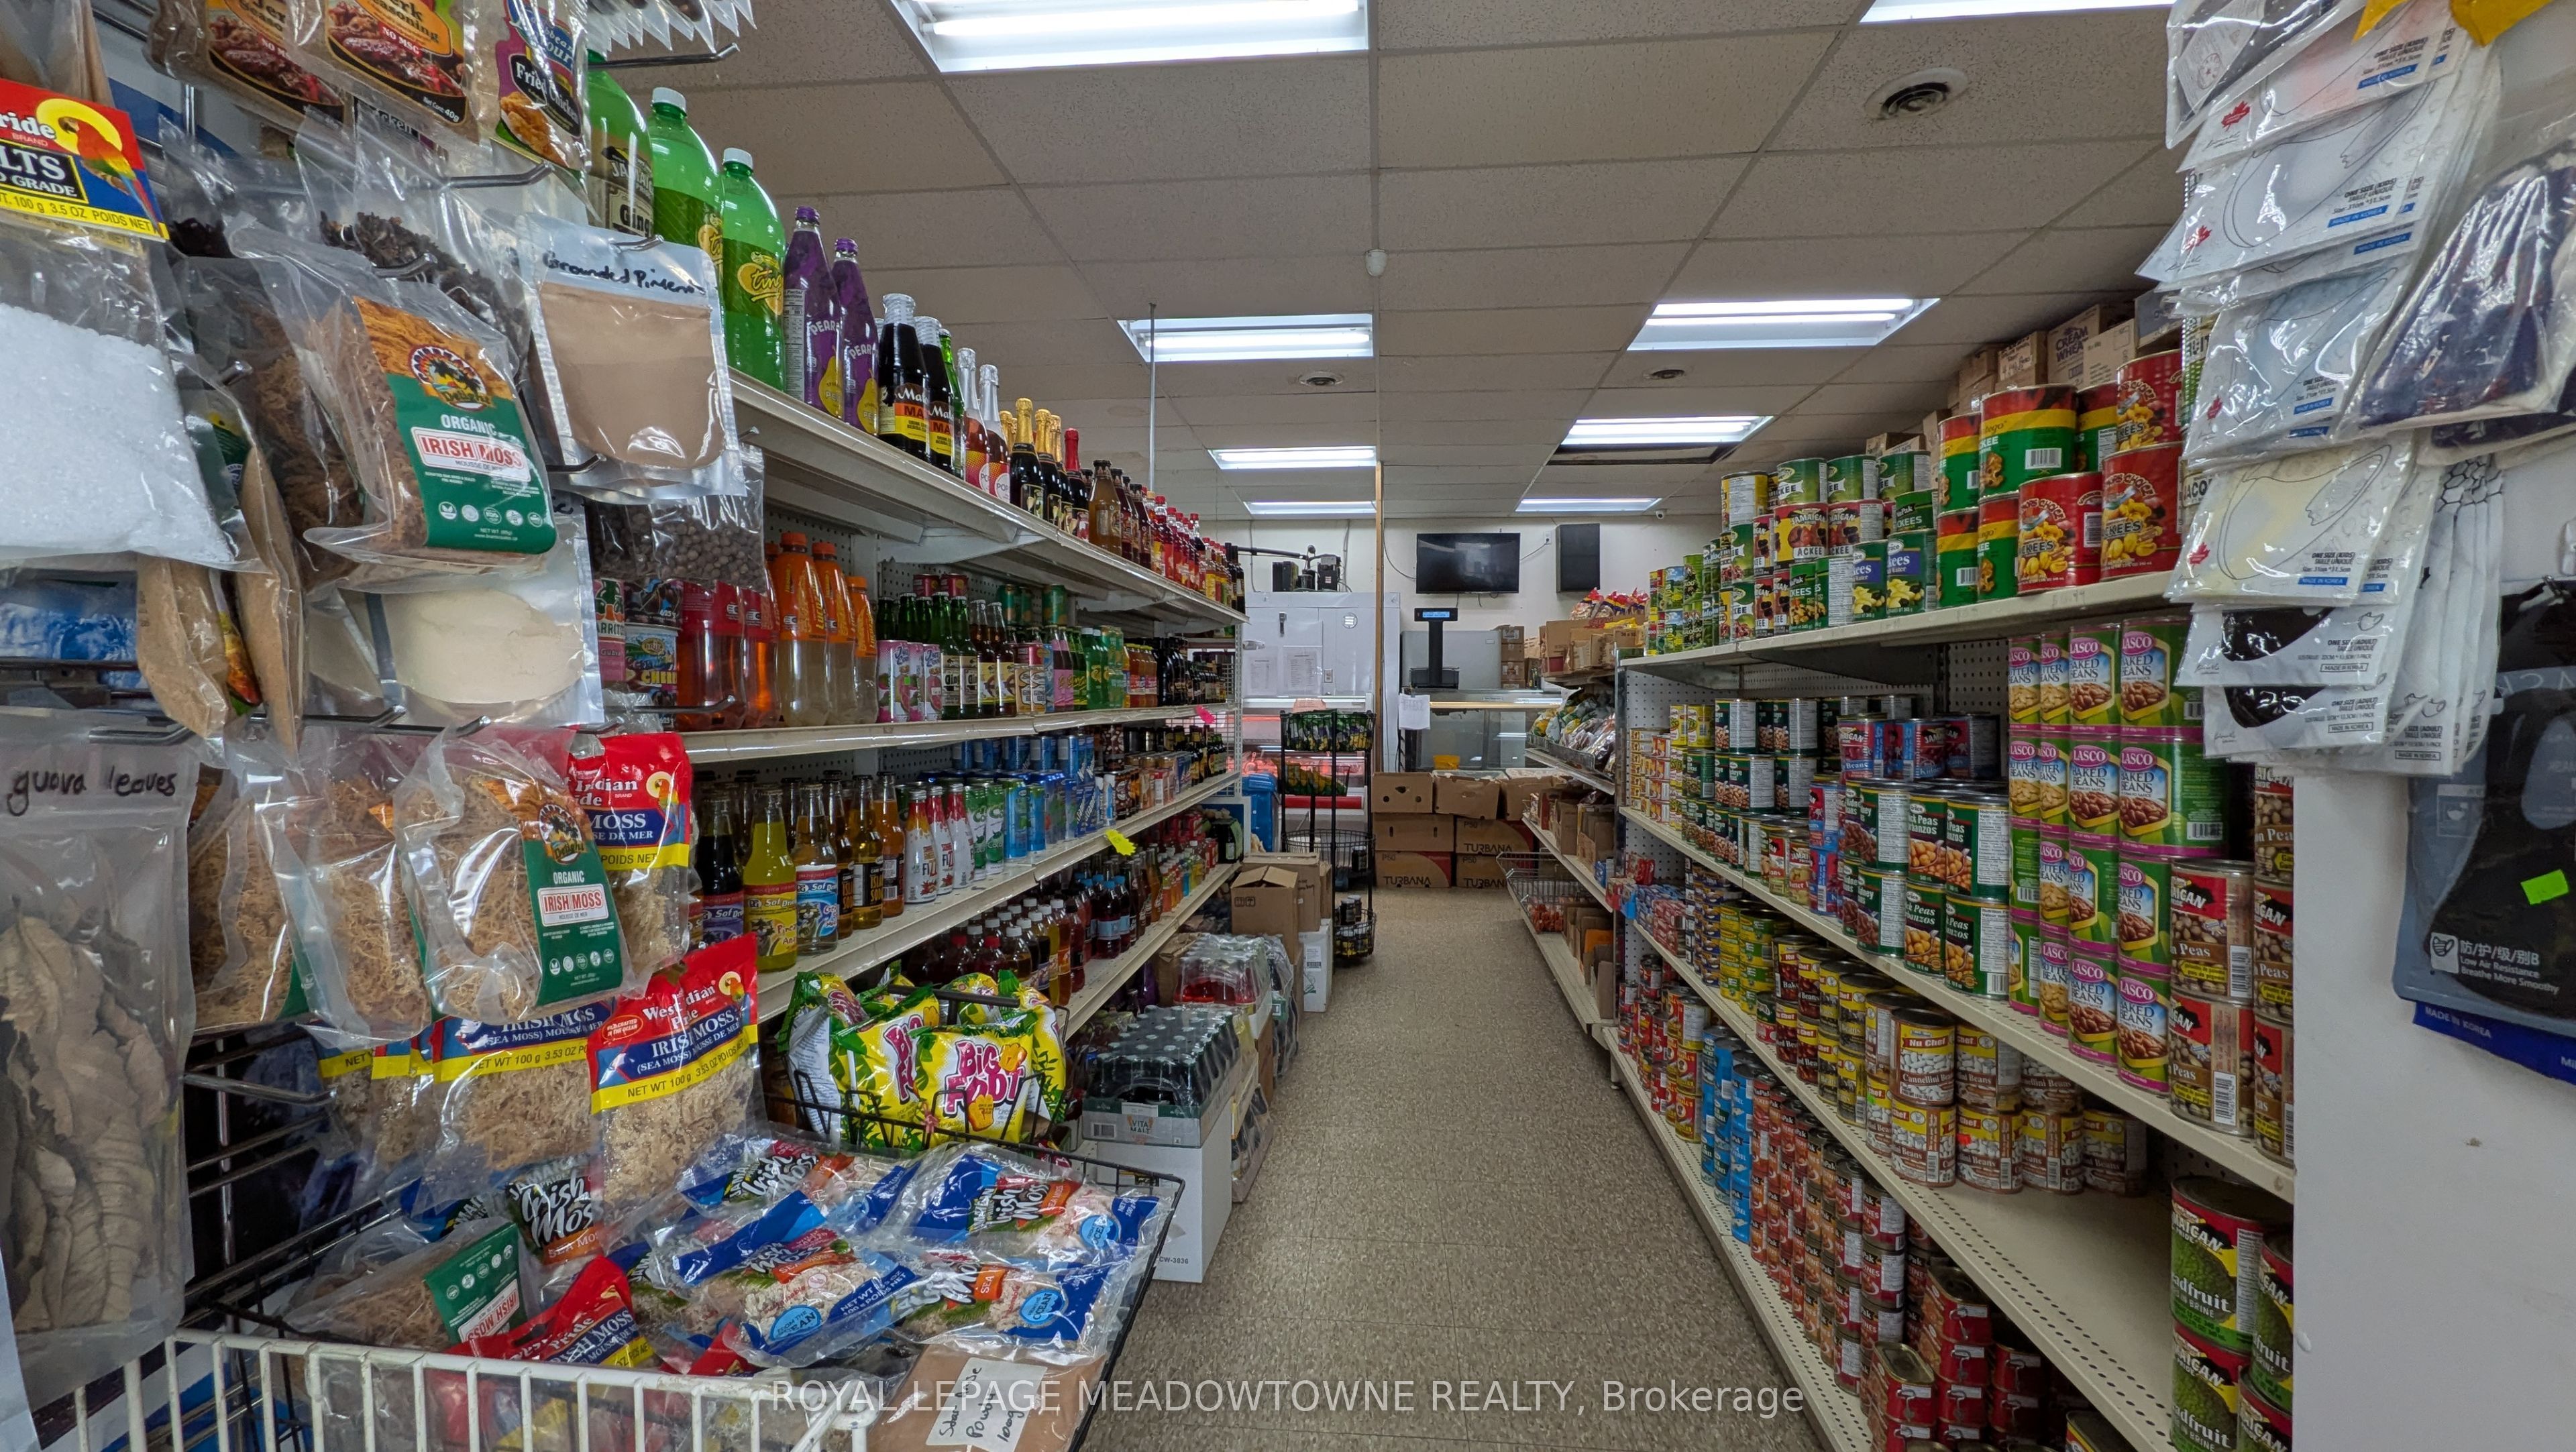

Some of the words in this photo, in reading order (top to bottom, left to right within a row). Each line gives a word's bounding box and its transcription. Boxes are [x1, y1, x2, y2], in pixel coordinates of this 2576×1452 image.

[383, 26, 396, 40] NO
[398, 37, 420, 54] MSG
[444, 109, 459, 123] 40g
[12, 133, 48, 147] BRAND
[12, 175, 77, 197] GRADE
[14, 195, 33, 209] 100
[50, 203, 66, 215] 3.5
[70, 207, 87, 219] OZ
[93, 210, 127, 227] POIDS
[130, 218, 151, 231] NET
[2056, 327, 2088, 351] CREAM
[2057, 341, 2084, 362] WHEA
[441, 414, 496, 435] ORGANIC
[421, 437, 474, 459] IRISH
[478, 444, 523, 468] MOSS
[1791, 511, 1827, 526] JAMAICAN
[1798, 547, 1823, 556] ACKEE
[1831, 547, 1850, 555] CKEE
[2070, 640, 2098, 654] LASCO
[2123, 635, 2152, 649] LASCO
[2074, 658, 2100, 669] AKED
[2123, 654, 2153, 666] AKED
[2074, 750, 2106, 762] LASCO
[2122, 752, 2153, 765] LASCO
[575, 778, 638, 792] Indian
[2073, 777, 2106, 788] BEANS
[2122, 781, 2153, 793] BEANS
[7, 771, 86, 816] guava
[109, 765, 178, 796] leaves
[590, 814, 646, 829] MOSS
[1918, 814, 1939, 826] Peas
[1949, 821, 1966, 834] Peas
[609, 832, 627, 840] DE
[632, 830, 653, 839] MER
[2266, 828, 2294, 842] Pea
[1464, 843, 1513, 852] TURBANA
[2040, 844, 2063, 859] ASCO
[601, 854, 634, 864] POIDS
[637, 853, 658, 863] NET
[553, 871, 585, 885] ORGANIC
[1383, 876, 1431, 885] TURBANA
[2119, 866, 2143, 883] ASCO
[1463, 878, 1507, 888] TURBAN
[2120, 887, 2143, 900] AKED
[2171, 886, 2206, 909] AICAN
[543, 894, 569, 912] IRISH
[572, 892, 602, 910] MOSS
[1913, 904, 1936, 917] Peas
[1949, 917, 1970, 931] Peas
[2180, 943, 2211, 958] Peas
[2072, 962, 2104, 979] LASCO
[2259, 963, 2290, 979] Peas
[2461, 956, 2477, 966] Low
[2479, 960, 2491, 969] Air
[2493, 962, 2540, 979] Resistance
[2043, 972, 2068, 985] BEAN
[2461, 966, 2492, 981] Breathe
[2493, 972, 2518, 985] More
[1801, 992, 1820, 1001] Beans
[2121, 980, 2153, 1000] LASCO
[2072, 991, 2103, 1006] BEANS
[642, 1003, 682, 1021] West
[2120, 1010, 2153, 1029] BEANS
[2425, 1007, 2451, 1021] MADE
[2452, 1015, 2461, 1026] IN
[2463, 1021, 2492, 1039] KOREA
[512, 1031, 543, 1042] MOSS)
[652, 1034, 693, 1058] IRIS
[694, 1009, 736, 1041] MOSS
[1909, 1039, 1923, 1048] Nu
[1924, 1038, 1946, 1048] Chef
[345, 1054, 363, 1067] NET
[471, 1058, 491, 1070] NET
[494, 1056, 512, 1068] WT
[515, 1054, 533, 1066] 100
[545, 1048, 563, 1060] 3.53
[564, 1046, 576, 1058] OZ
[637, 1062, 661, 1074] (SEA
[663, 1050, 692, 1065] MOSS)
[628, 1085, 647, 1097] NET
[650, 1080, 665, 1093] WT
[671, 1075, 686, 1088] 100
[686, 1074, 692, 1082] g
[696, 1064, 710, 1076] 3.53
[710, 1057, 718, 1068] OZ
[1902, 1073, 1939, 1084] Cannellini
[2173, 1063, 2197, 1080] Peas
[1970, 1074, 1992, 1085] Beans
[944, 1064, 1024, 1119] FOOT
[1130, 1127, 1150, 1135] MALT
[1132, 1119, 1149, 1128] VITA
[1902, 1148, 1923, 1161] Beans
[1974, 1156, 1996, 1168] Beans
[2173, 1215, 2223, 1253] MAICAN
[890, 1272, 907, 1288] NET
[980, 1275, 995, 1294] SEA
[841, 1298, 859, 1312] NET
[859, 1289, 873, 1302] WT
[2174, 1274, 2232, 1314] adfruit
[496, 1291, 517, 1319] IRISH
[2189, 1300, 2214, 1319] BRINE
[596, 1310, 634, 1345] MOSS
[2255, 1336, 2292, 1374] fruit
[2174, 1348, 2226, 1388] MAICAN
[2174, 1405, 2232, 1449] adfruit
